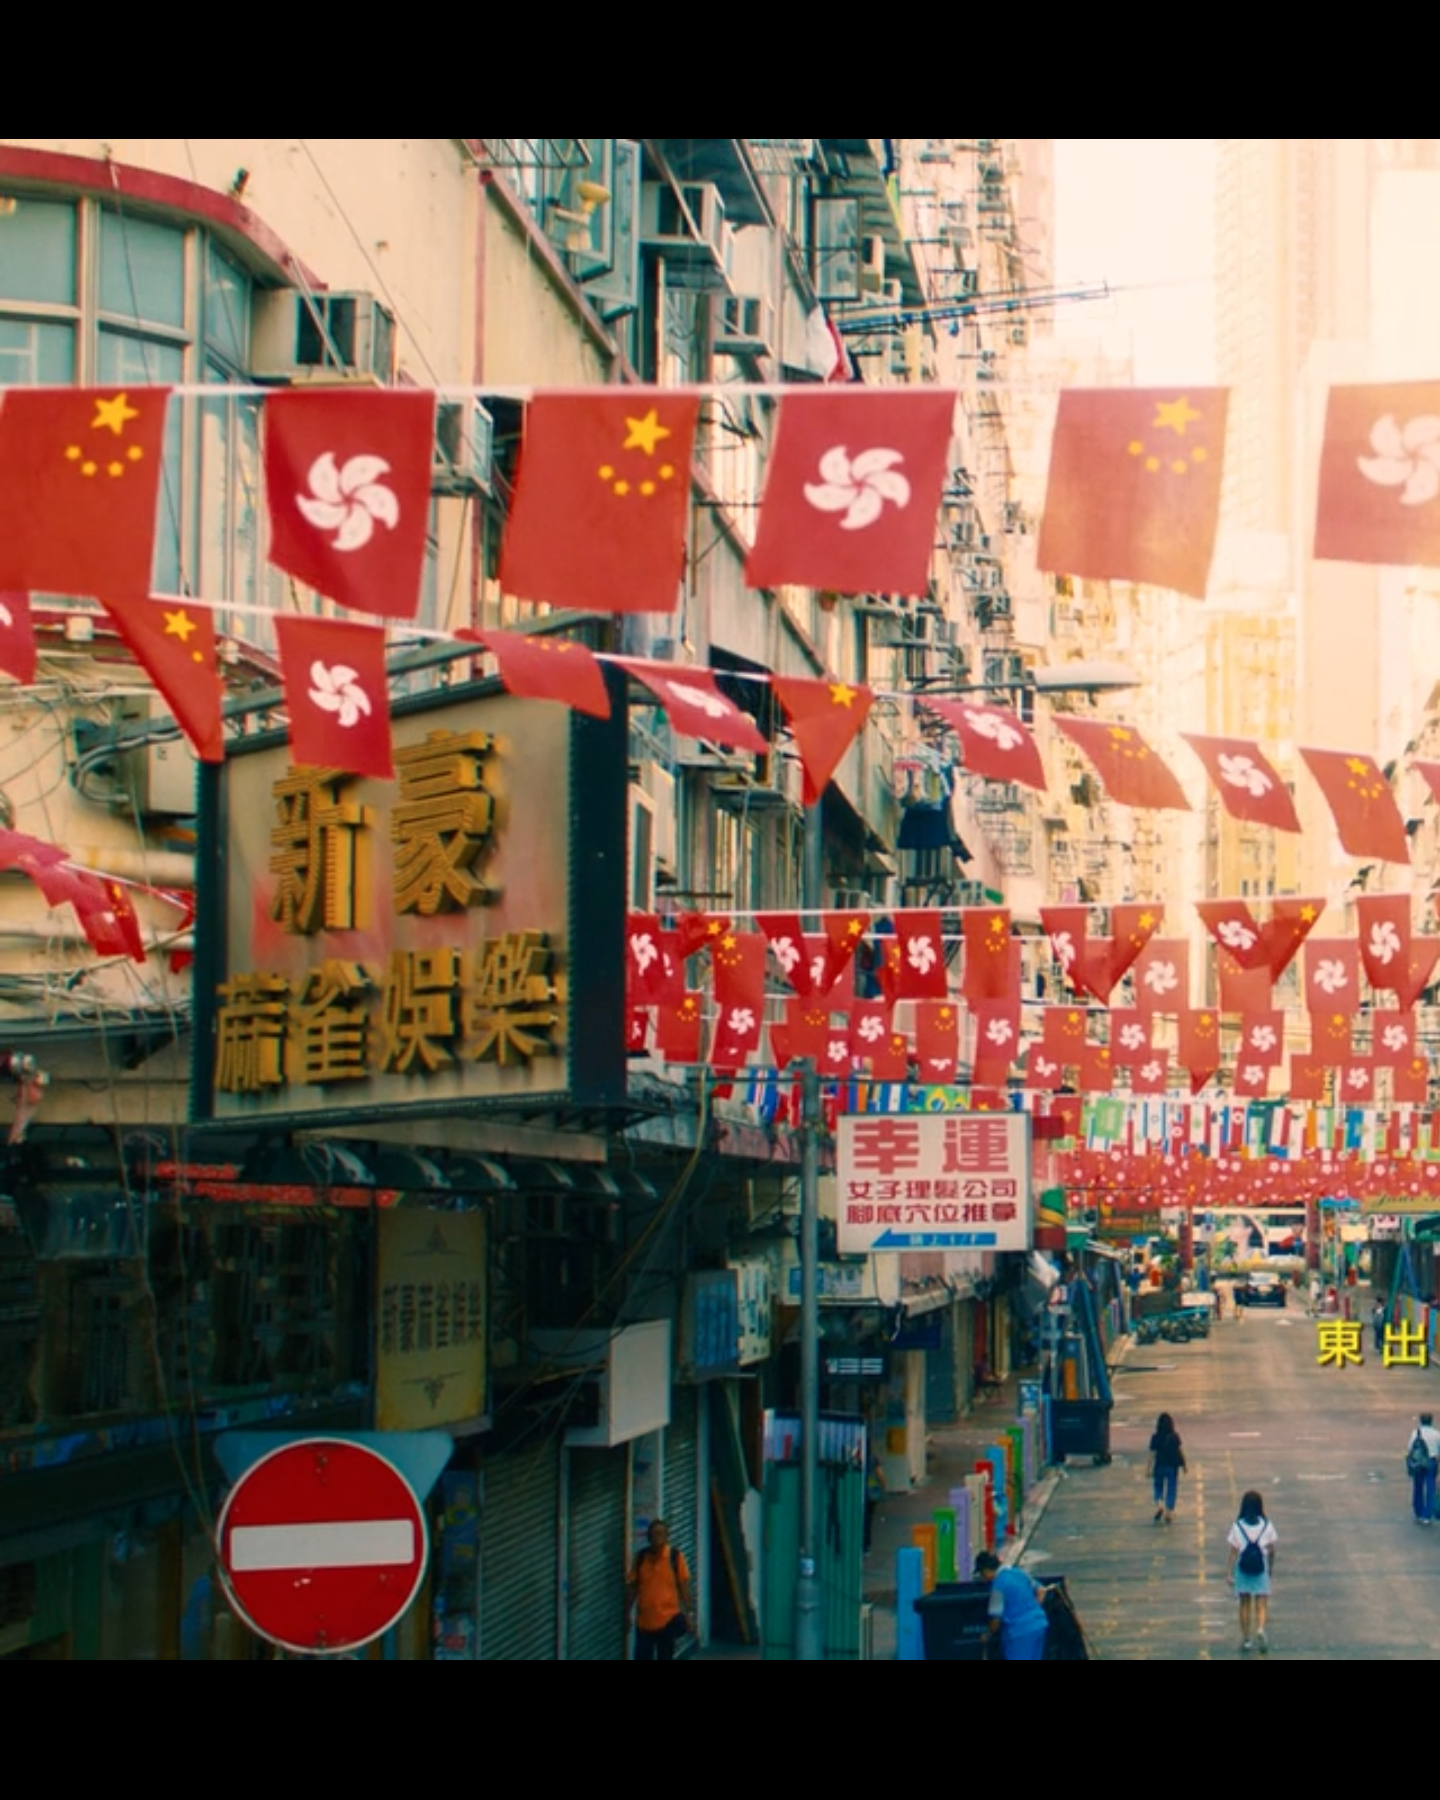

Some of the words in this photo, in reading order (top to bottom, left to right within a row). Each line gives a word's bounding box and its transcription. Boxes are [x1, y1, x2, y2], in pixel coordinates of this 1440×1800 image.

[268, 729, 504, 936] 新豪
[213, 928, 560, 1093] 麻雀娛樂
[846, 1178, 1018, 1200] 女子理髮公司
[853, 1118, 1009, 1175] 幸運
